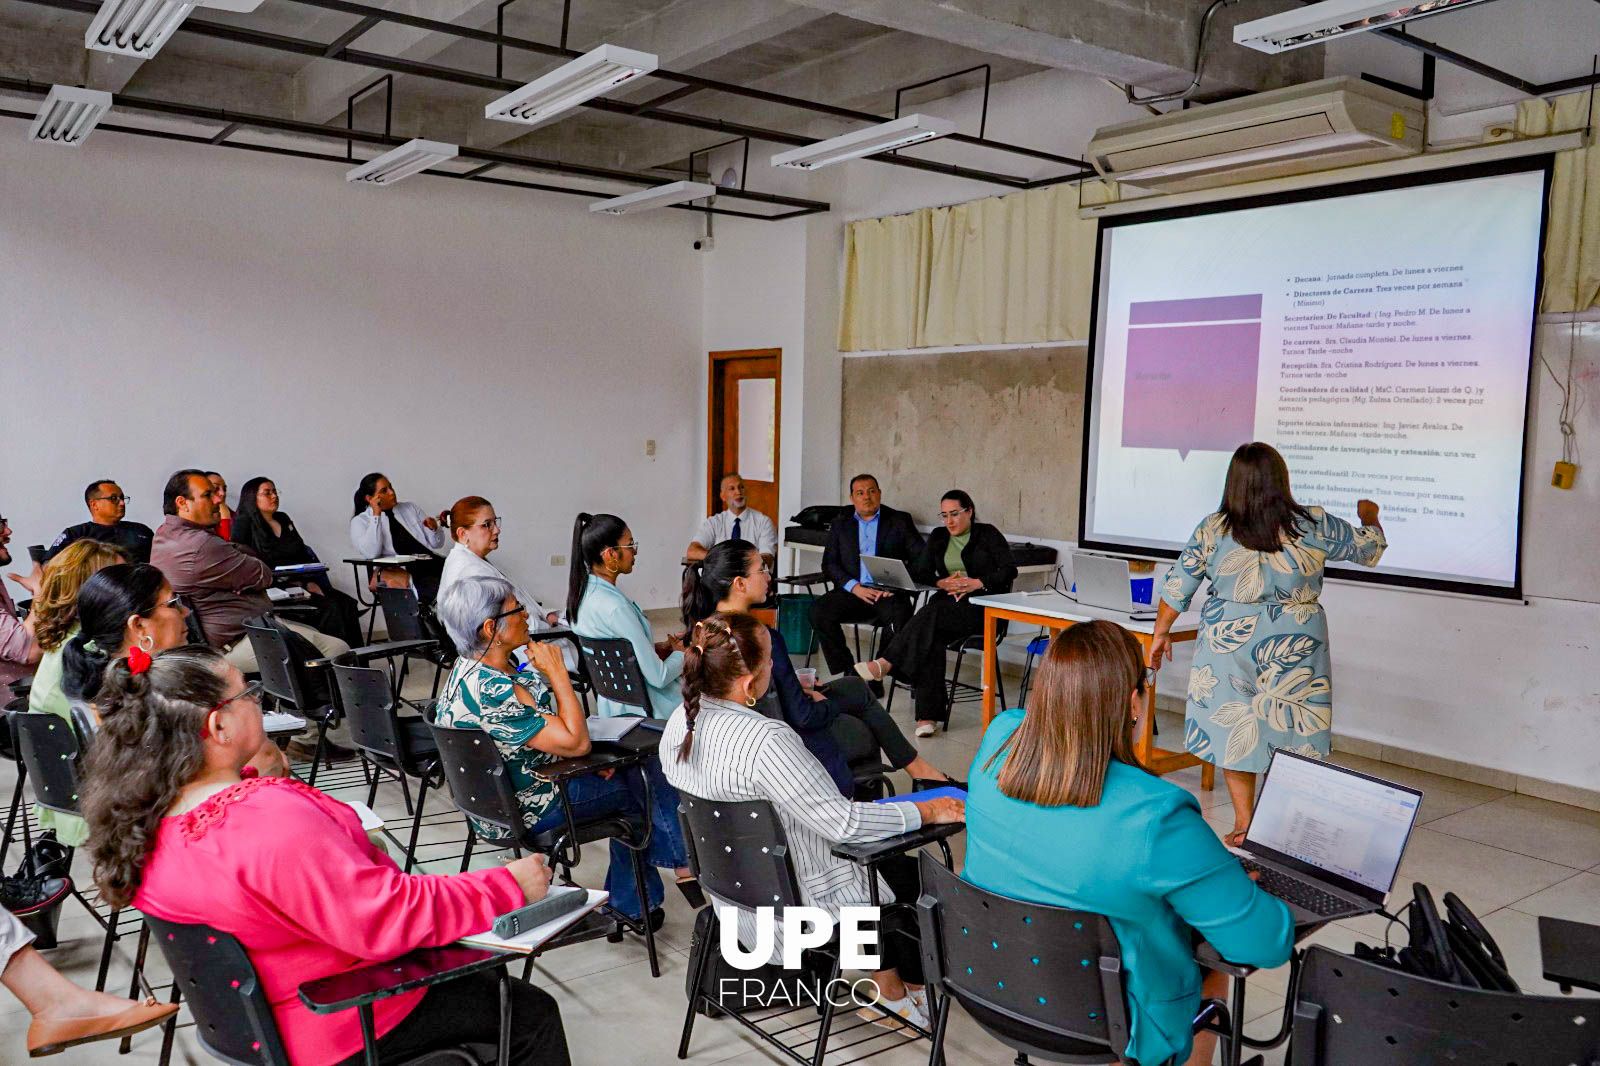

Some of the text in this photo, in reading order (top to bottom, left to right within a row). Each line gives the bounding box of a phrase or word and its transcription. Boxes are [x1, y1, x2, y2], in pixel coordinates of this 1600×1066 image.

[1293, 290, 1331, 298] Directores
[1417, 284, 1430, 292] por
[1468, 397, 1484, 406] por
[1277, 419, 1303, 427] Soporte
[1416, 492, 1431, 500] por
